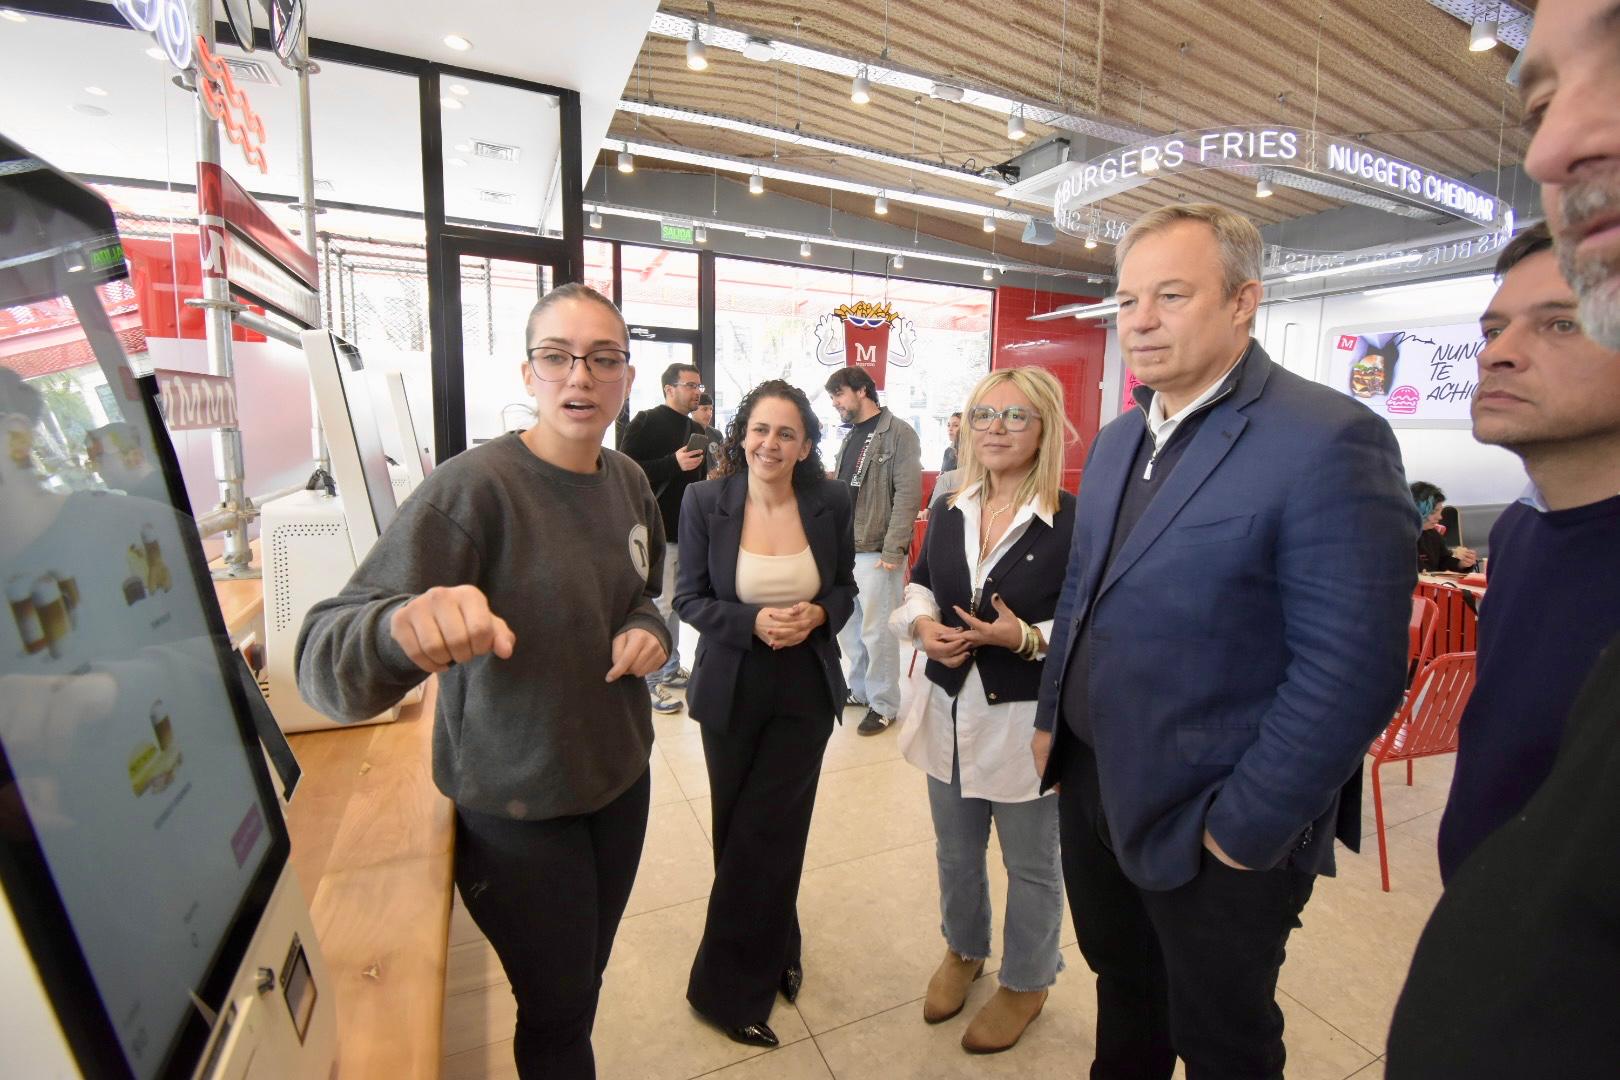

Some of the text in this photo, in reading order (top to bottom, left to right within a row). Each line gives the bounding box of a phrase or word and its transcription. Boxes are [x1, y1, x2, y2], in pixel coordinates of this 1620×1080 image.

[1061, 131, 1297, 203] BURGERS FRIES
[1328, 144, 1494, 221] NUGGETS CHEDDAR
[854, 342, 877, 363] M
[1341, 337, 1354, 349] M
[1430, 361, 1454, 382] TE
